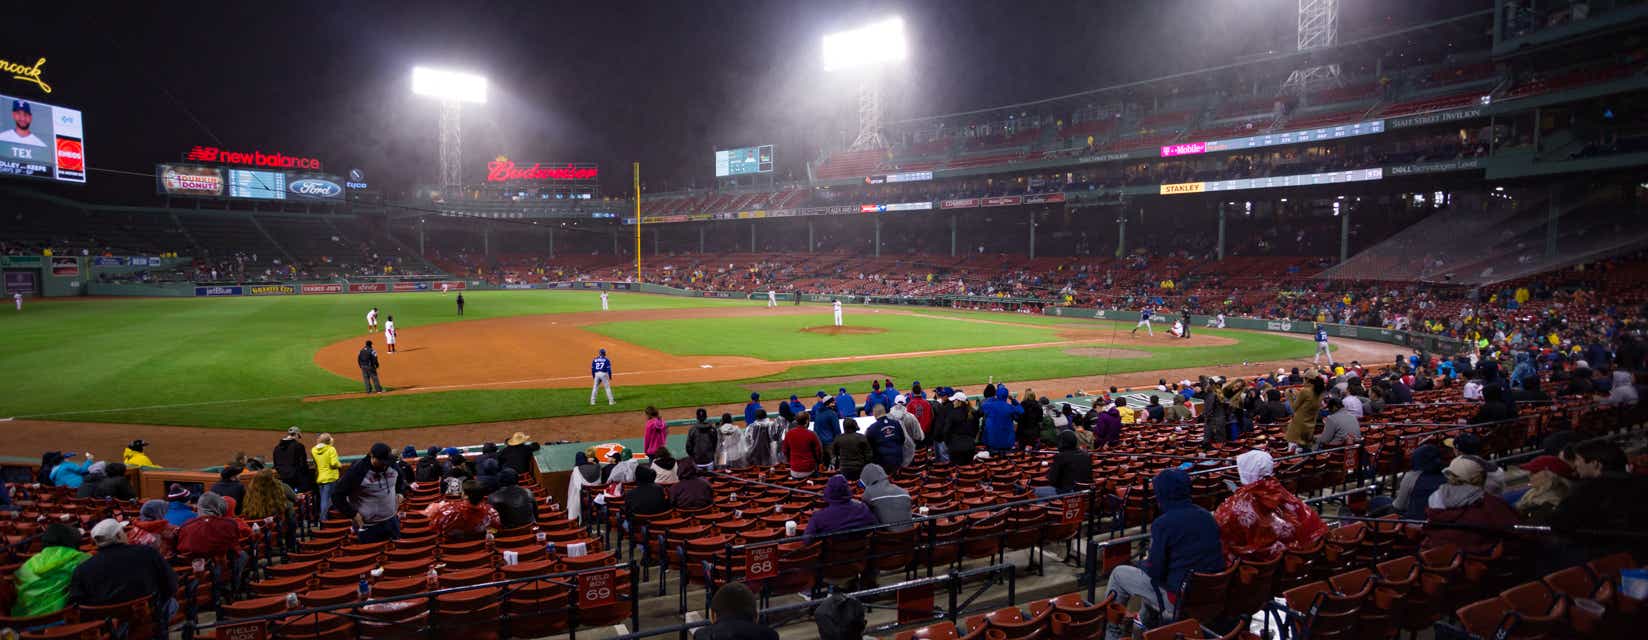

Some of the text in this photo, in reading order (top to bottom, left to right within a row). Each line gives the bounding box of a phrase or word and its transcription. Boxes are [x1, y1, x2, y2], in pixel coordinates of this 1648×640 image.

[1442, 109, 1480, 121] PAVILION
[11, 147, 32, 158] TEX
[220, 151, 254, 165] new
[255, 150, 320, 169] balance
[487, 160, 598, 181] Budweiser
[300, 182, 331, 195] Ford
[1165, 184, 1200, 193] STANLEY
[595, 362, 605, 370] 27
[1065, 508, 1080, 519] 67
[750, 560, 773, 574] 68
[585, 586, 610, 600] 69
